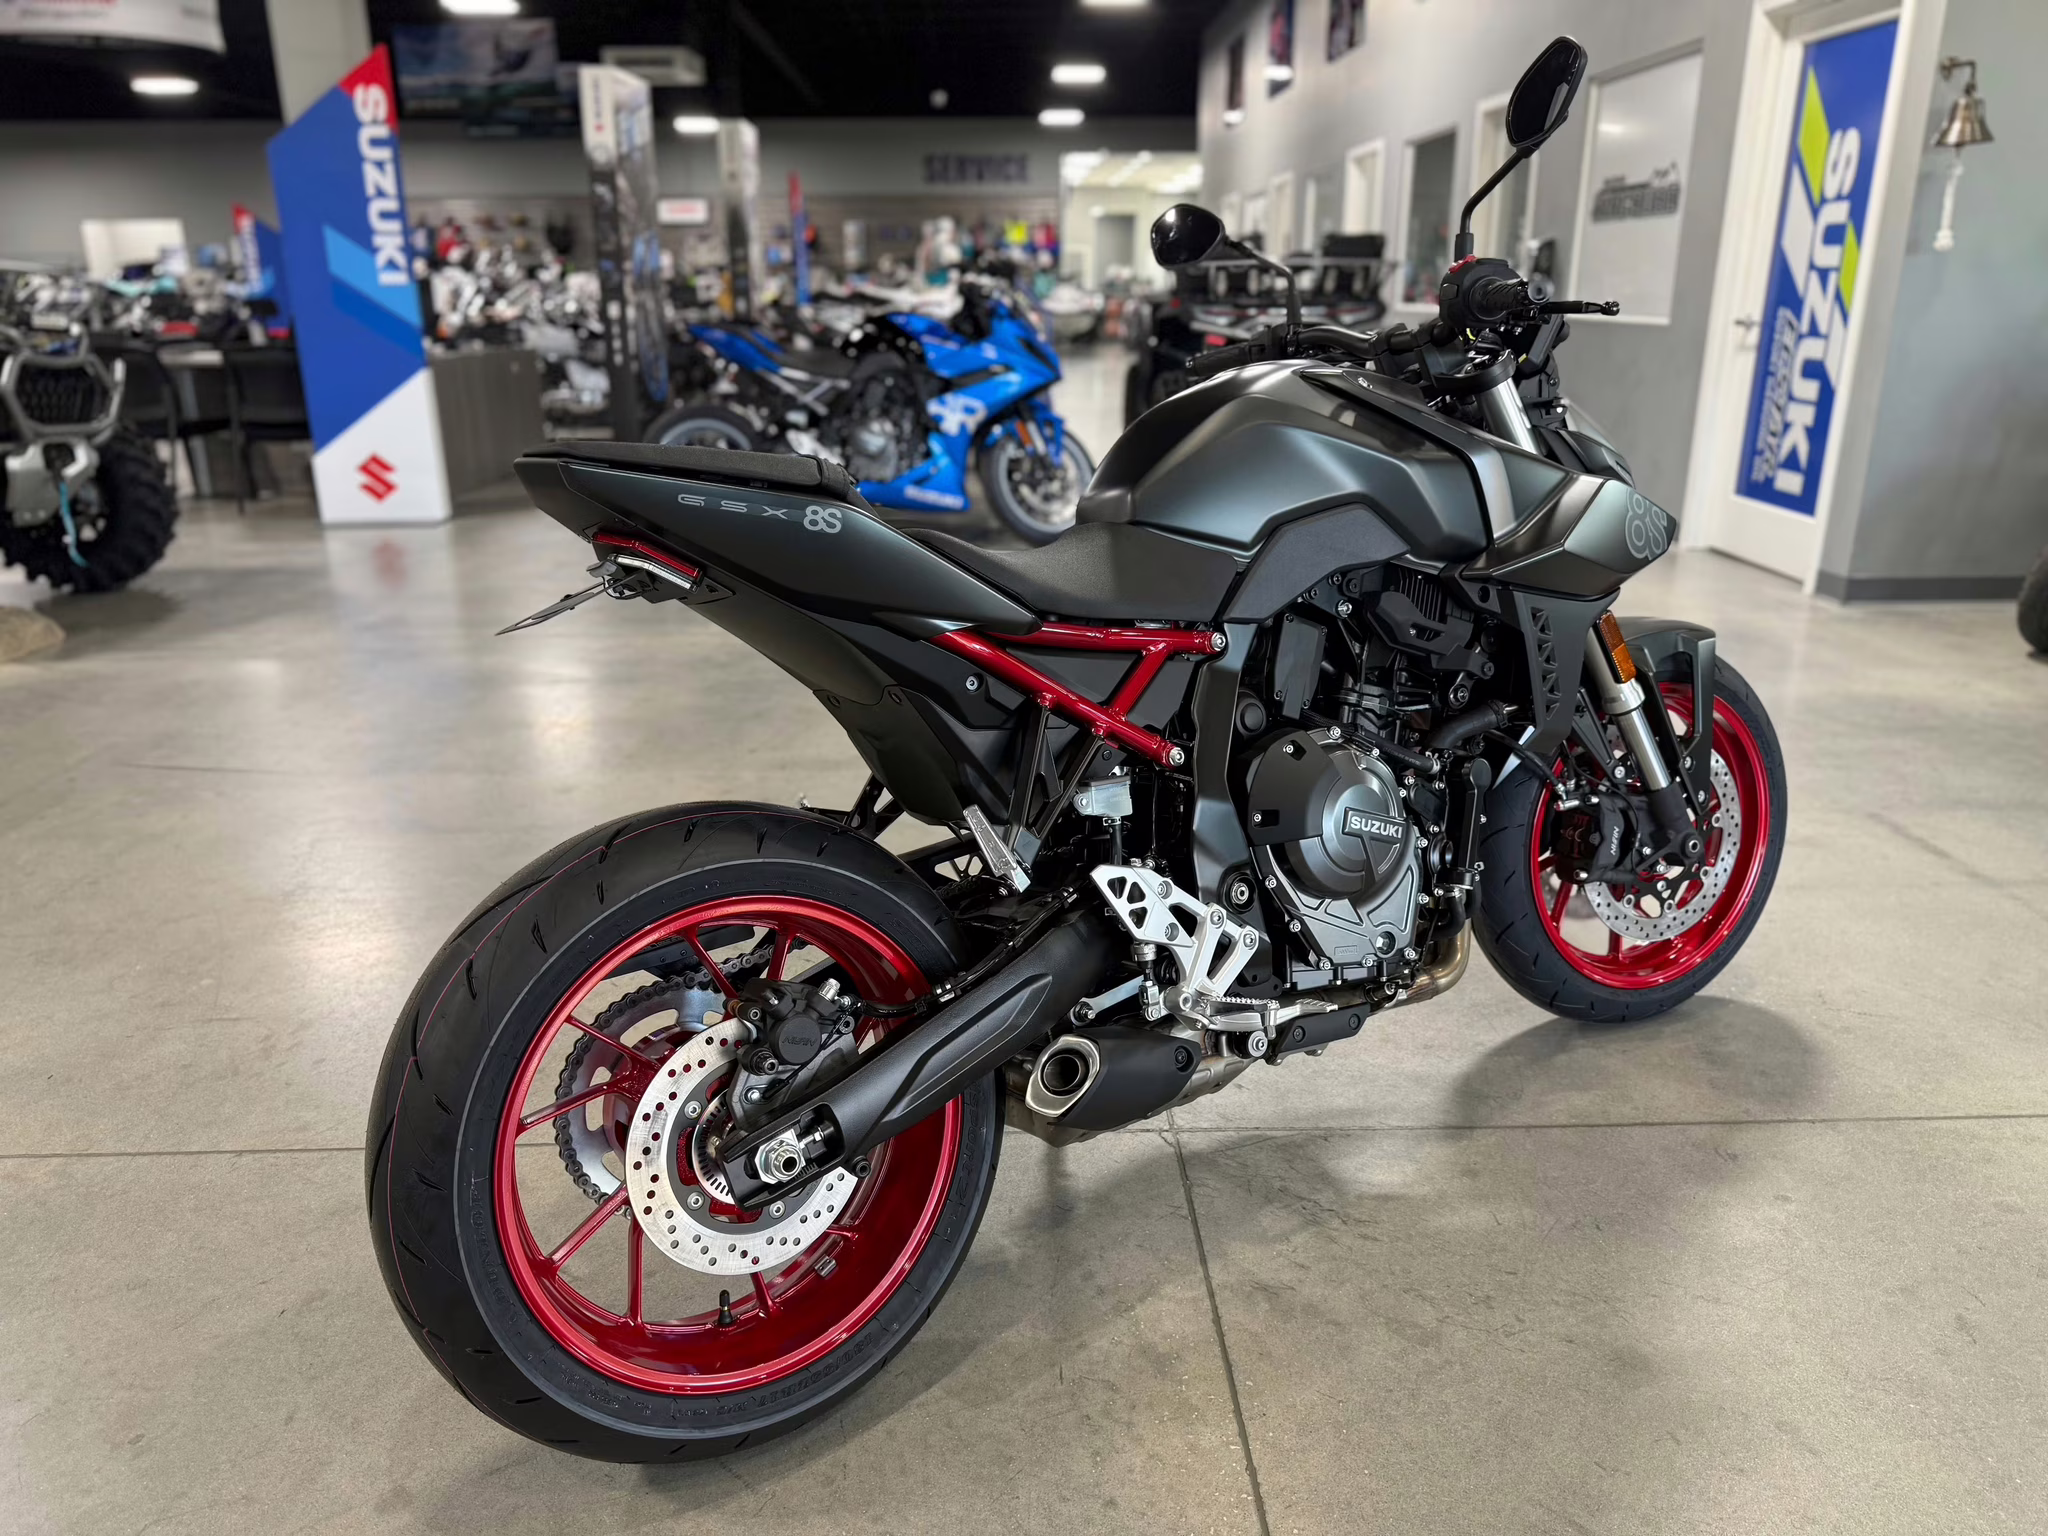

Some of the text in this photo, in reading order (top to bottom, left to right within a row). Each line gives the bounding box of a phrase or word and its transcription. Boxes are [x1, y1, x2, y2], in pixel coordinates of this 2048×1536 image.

[353, 83, 410, 286] SUZUKI
[1772, 127, 1861, 497] SUZUKI
[804, 506, 842, 533] 8S
[1350, 816, 1403, 838] SUZUKI
